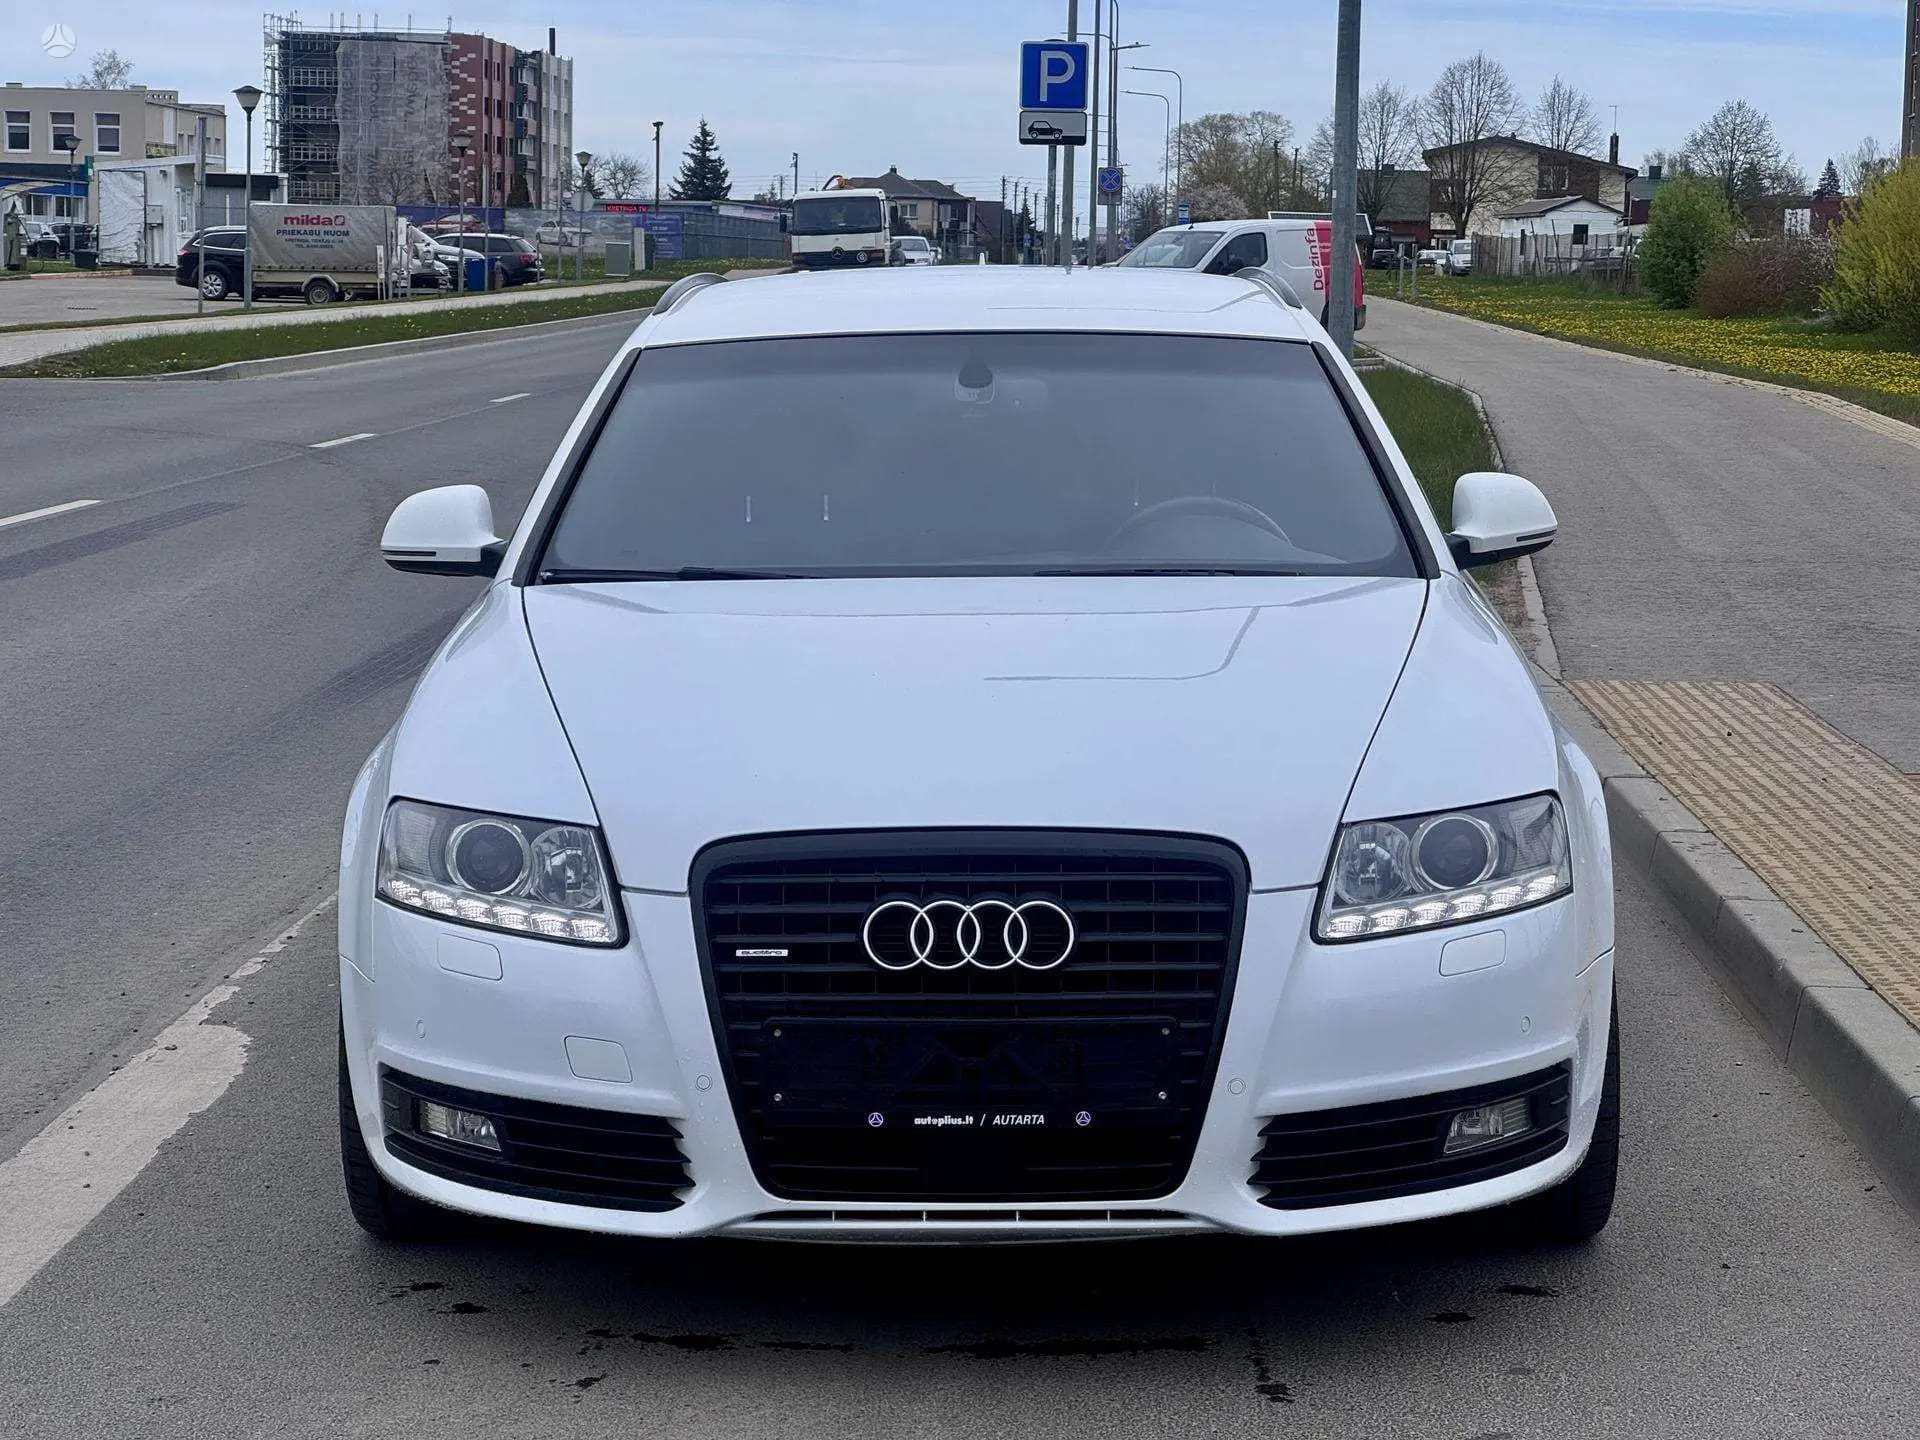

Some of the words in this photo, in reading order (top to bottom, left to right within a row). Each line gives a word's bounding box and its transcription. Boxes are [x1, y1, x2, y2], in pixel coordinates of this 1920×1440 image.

[1040, 51, 1075, 101] P
[283, 214, 333, 226] milda
[1305, 228, 1324, 291] Dezinfa
[914, 1114, 974, 1127] autoplius.lt
[992, 1113, 1046, 1126] AUTARTA
